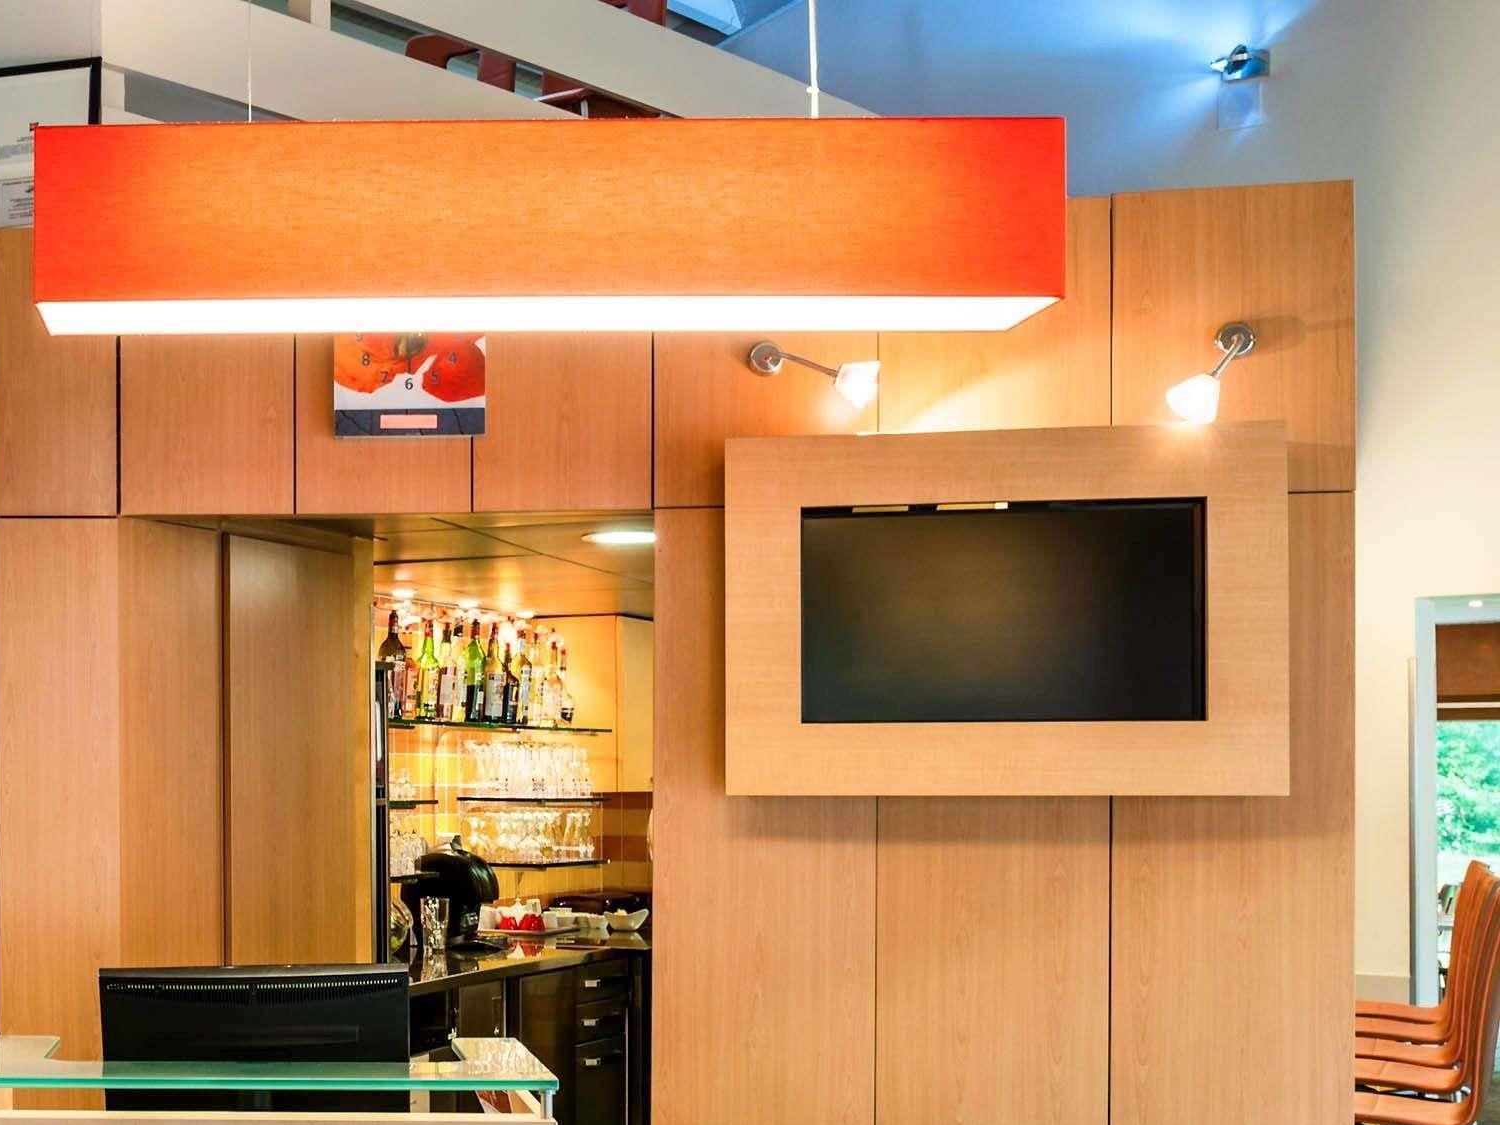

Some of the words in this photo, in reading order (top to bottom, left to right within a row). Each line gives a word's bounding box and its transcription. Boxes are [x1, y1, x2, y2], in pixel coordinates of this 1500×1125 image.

[362, 352, 370, 366] 8
[448, 352, 458, 364] 4
[380, 371, 389, 383] 7
[404, 377, 414, 390] 6
[431, 370, 439, 384] 5
